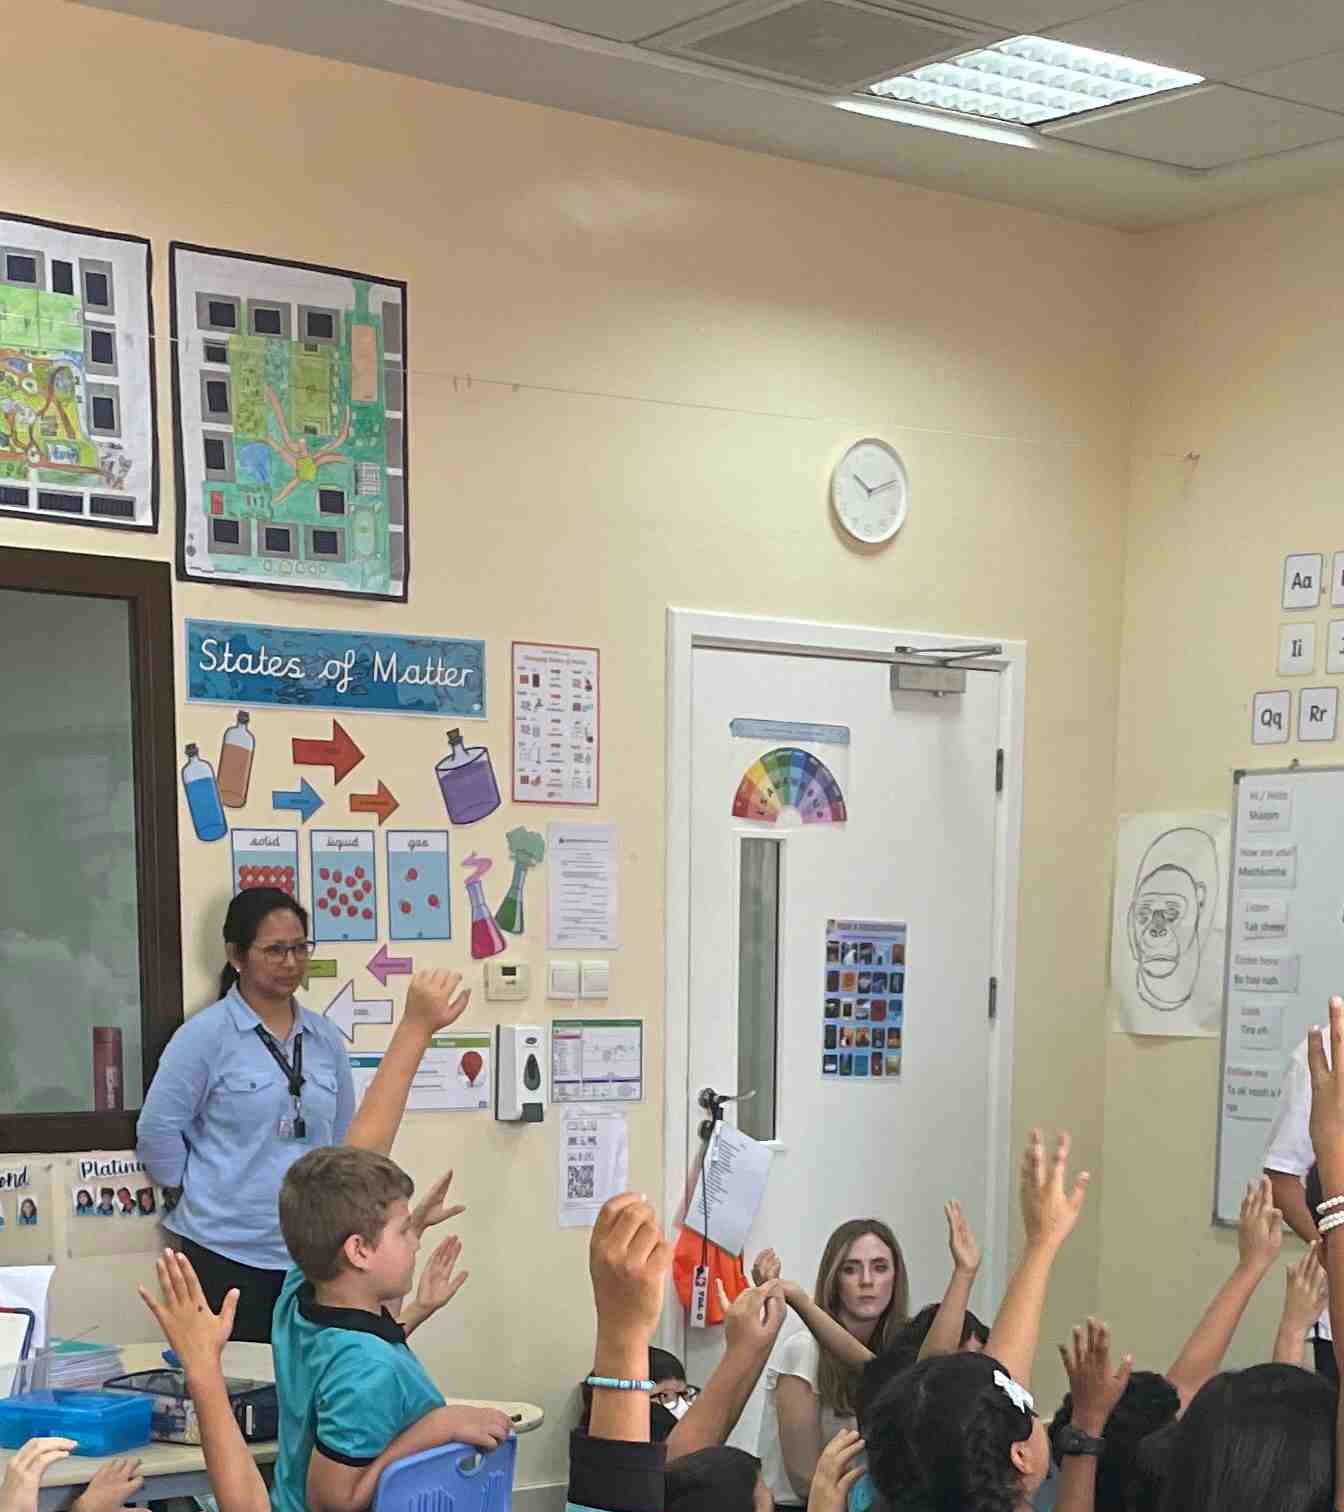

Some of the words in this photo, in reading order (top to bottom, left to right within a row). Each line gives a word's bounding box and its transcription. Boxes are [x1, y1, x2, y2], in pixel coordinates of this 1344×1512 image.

[1291, 572, 1313, 590] Aa
[1291, 639, 1303, 657] Ii
[198, 637, 308, 682] States
[317, 648, 356, 694] of
[371, 650, 475, 688] Matter
[1260, 708, 1282, 730] Qq
[1309, 704, 1328, 722] Rr
[80, 1158, 147, 1179] Platinu
